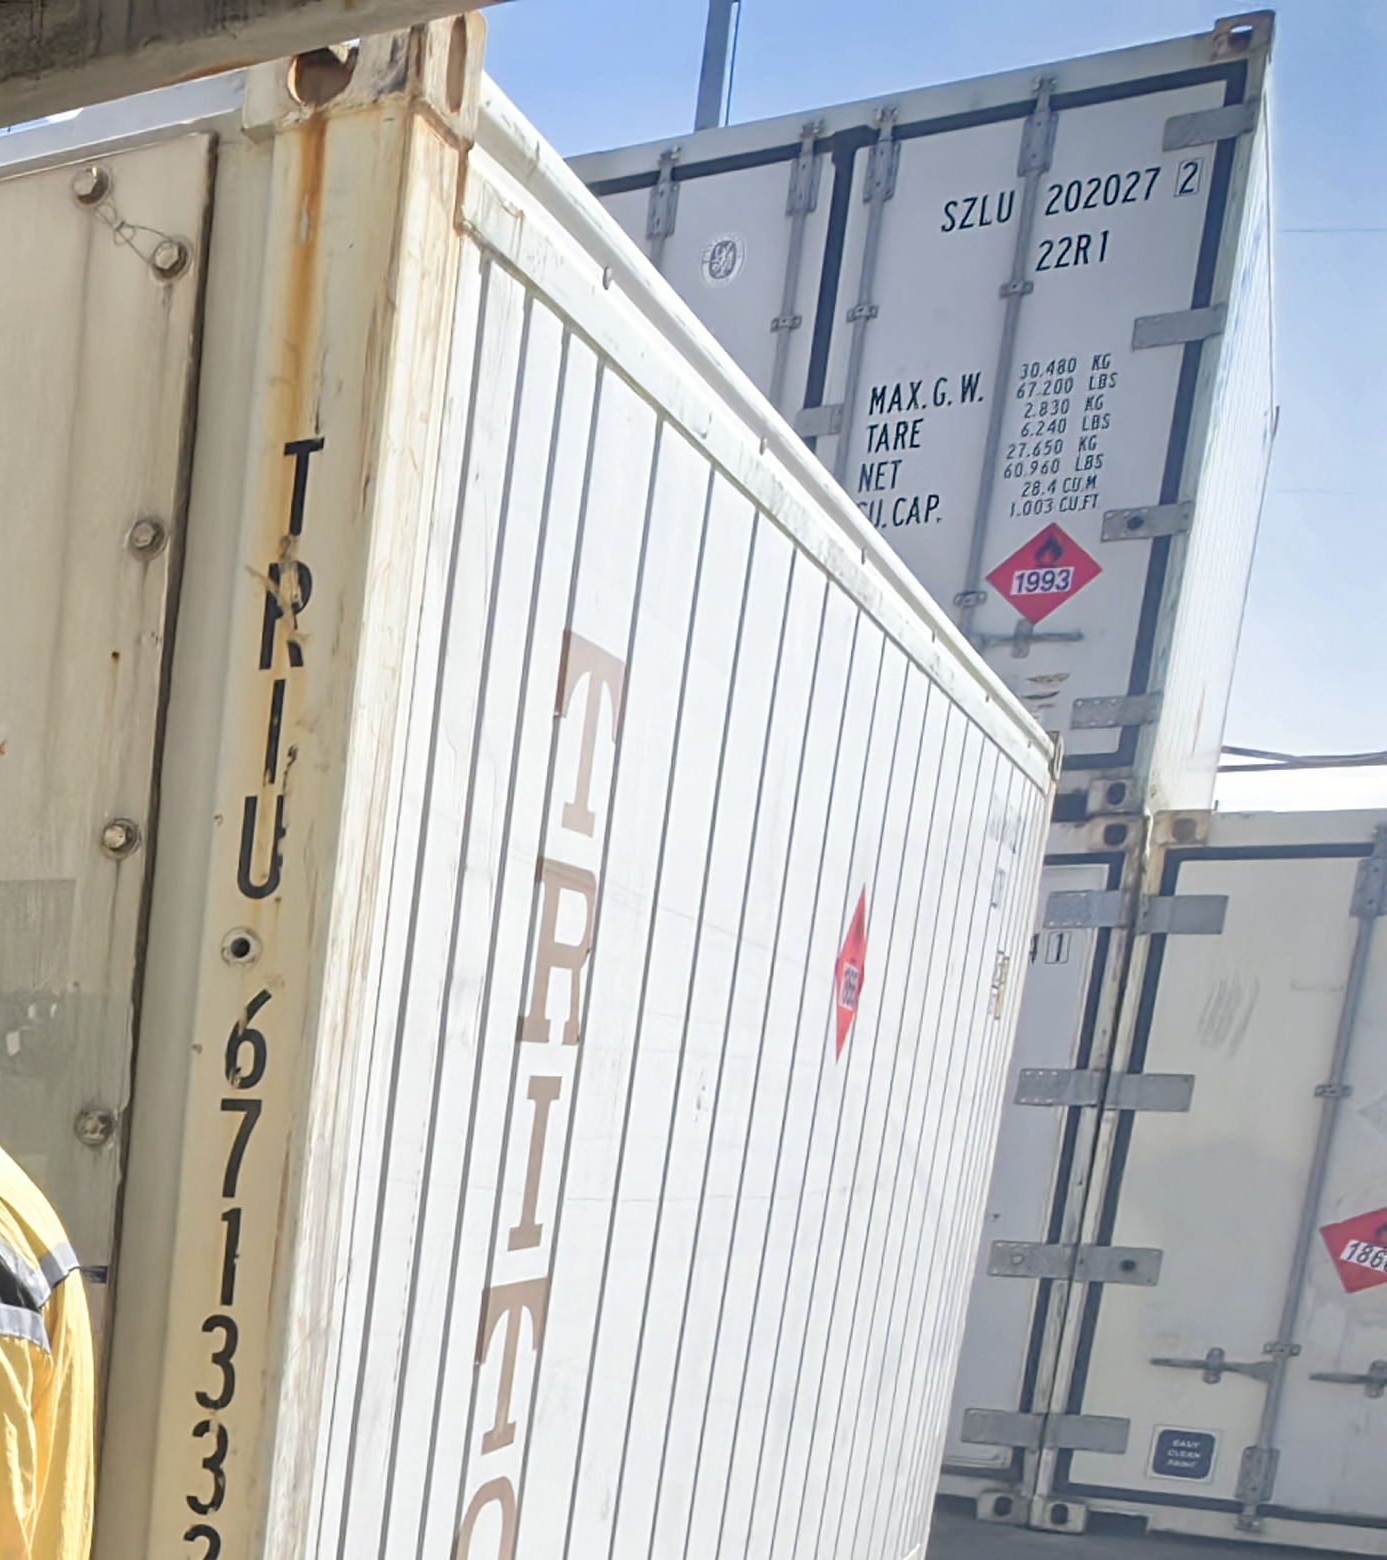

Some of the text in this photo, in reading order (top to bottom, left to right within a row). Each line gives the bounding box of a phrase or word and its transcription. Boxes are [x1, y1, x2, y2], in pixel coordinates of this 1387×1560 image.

[940, 161, 1199, 233] SZLU 202027 2
[1035, 230, 1109, 271] 22R1
[1020, 353, 1111, 380] 30.480 KG
[1089, 372, 1118, 391] LBS
[1024, 394, 1104, 419] 2.830 KG
[866, 418, 924, 453] TARE
[1020, 414, 1111, 437] 6.240 LBS
[1078, 435, 1097, 452] KG
[1075, 454, 1104, 472] LBS
[858, 459, 902, 493] NET
[1021, 480, 1056, 498] 28.4
[1014, 569, 1071, 594] 1993
[237, 436, 325, 900] TRIU
